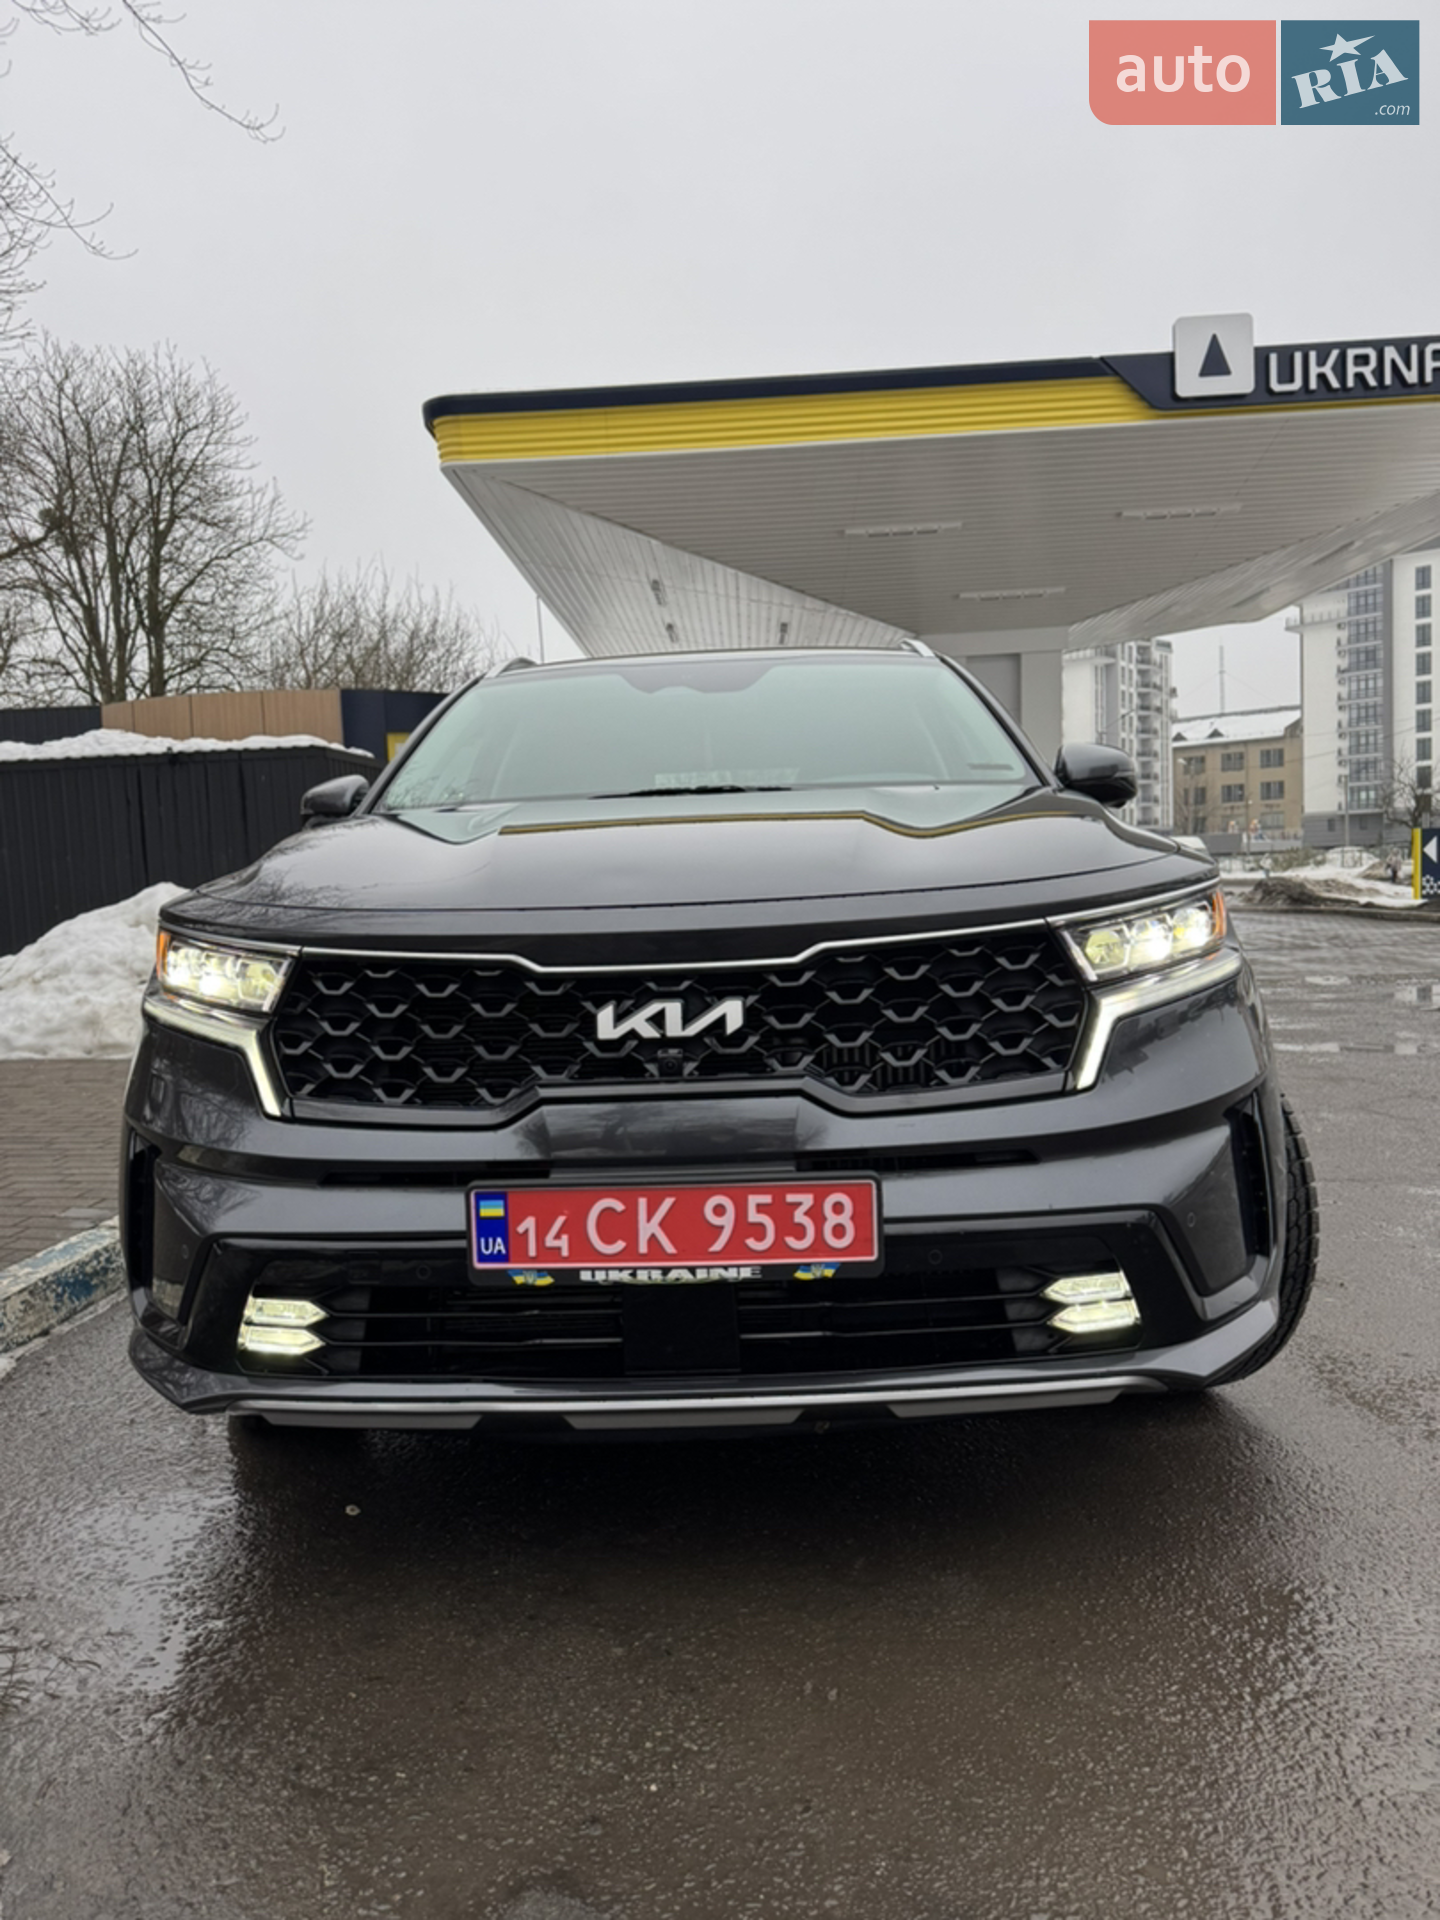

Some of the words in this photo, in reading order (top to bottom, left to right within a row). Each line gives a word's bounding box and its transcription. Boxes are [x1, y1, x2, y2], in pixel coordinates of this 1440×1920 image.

[596, 999, 744, 1040] KIA
[516, 1215, 570, 1258] 14
[586, 1196, 678, 1255] CK
[703, 1192, 856, 1252] 9538
[480, 1237, 506, 1255] UA
[579, 1265, 763, 1282] UKRAINE
